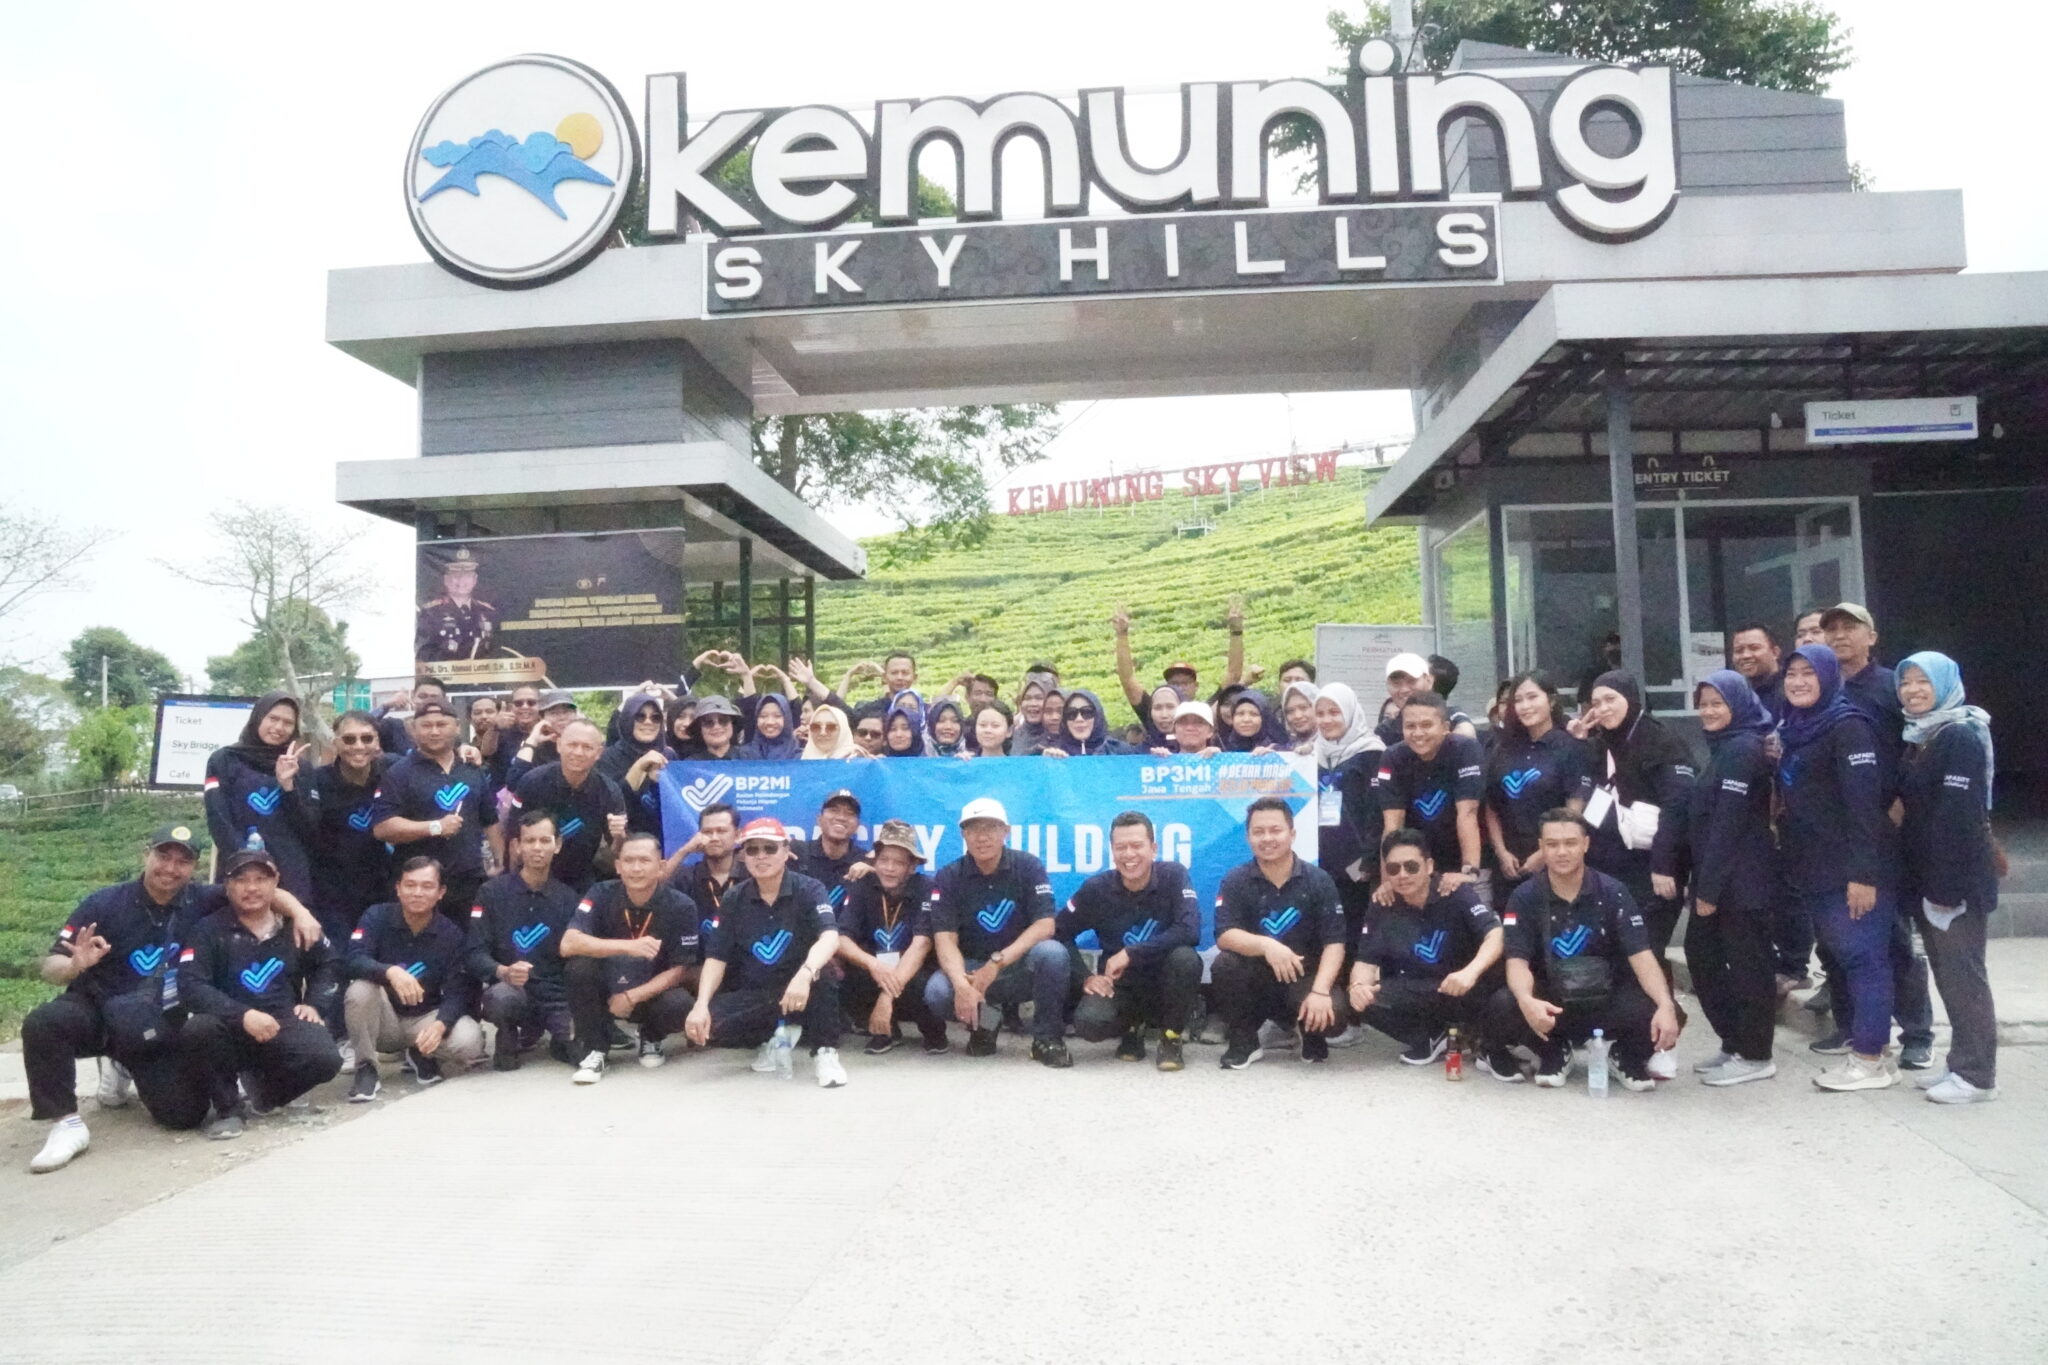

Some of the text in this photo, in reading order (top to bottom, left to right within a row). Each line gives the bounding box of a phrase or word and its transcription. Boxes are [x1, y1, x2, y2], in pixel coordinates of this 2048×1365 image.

[646, 39, 1680, 241] kemuning
[714, 213, 1488, 299] SKY HILLS
[1822, 411, 1857, 421] Ticket
[1007, 450, 1341, 515] KEMUNING SKY VIEW
[1634, 470, 1730, 485] ENTRY TICKET
[175, 716, 202, 725] Ticket
[172, 740, 220, 751] Sky Bridge
[1140, 765, 1211, 783] BP3MI
[735, 775, 790, 790] BP2MI
[1141, 785, 1167, 794] Jawa
[1173, 783, 1211, 795] Tengah
